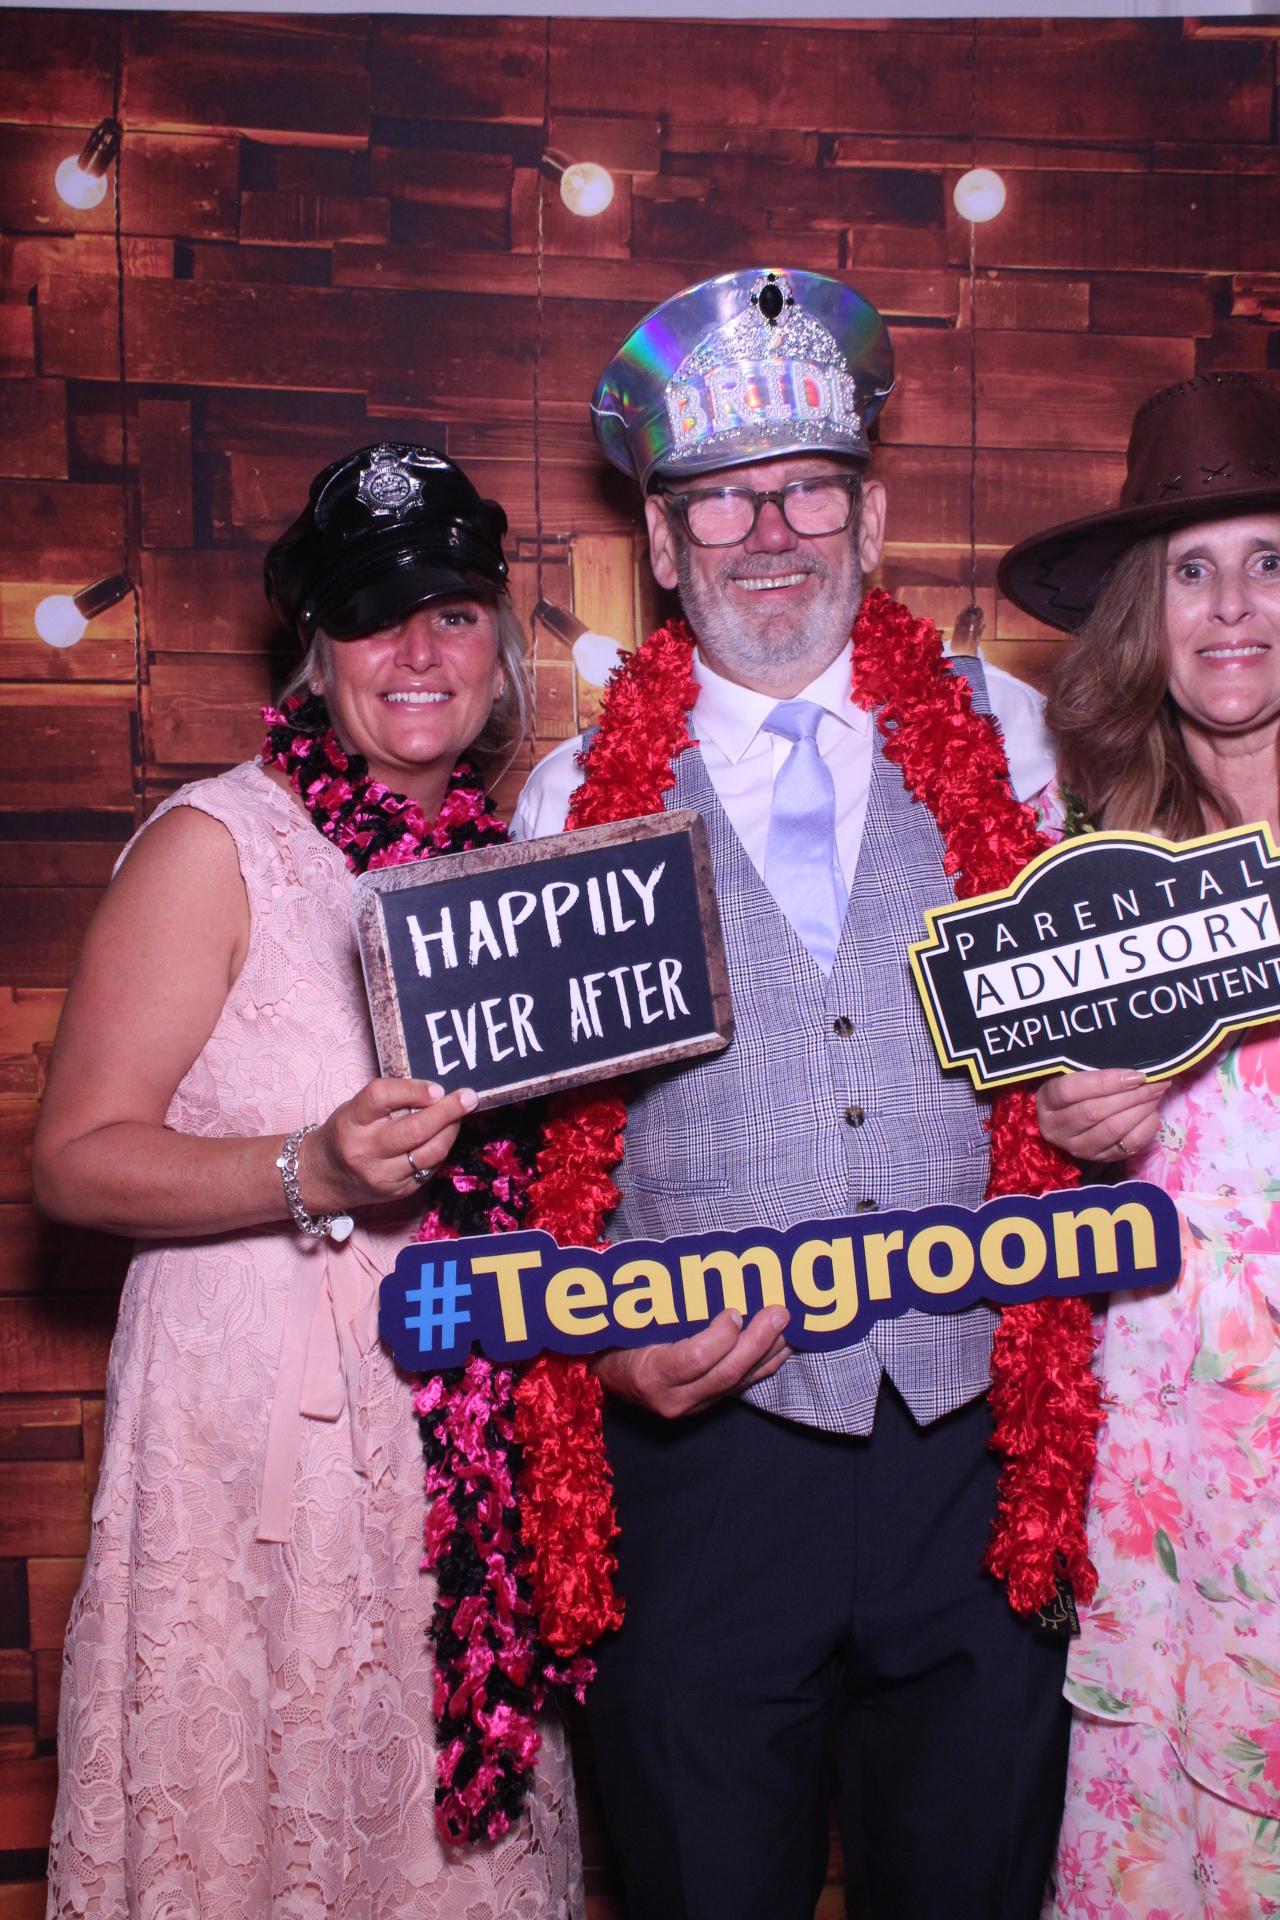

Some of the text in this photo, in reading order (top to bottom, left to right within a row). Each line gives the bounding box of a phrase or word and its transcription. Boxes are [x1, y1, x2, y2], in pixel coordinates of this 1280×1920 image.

[406, 861, 666, 978] HAPPILY
[956, 860, 1263, 960] PARENTAL
[976, 901, 1269, 1011] ADVISORY
[425, 958, 691, 1075] EVER AFTER
[983, 959, 1280, 1056] EXPLICIT CONTENT
[404, 1202, 1157, 1352] #Teamgroom
